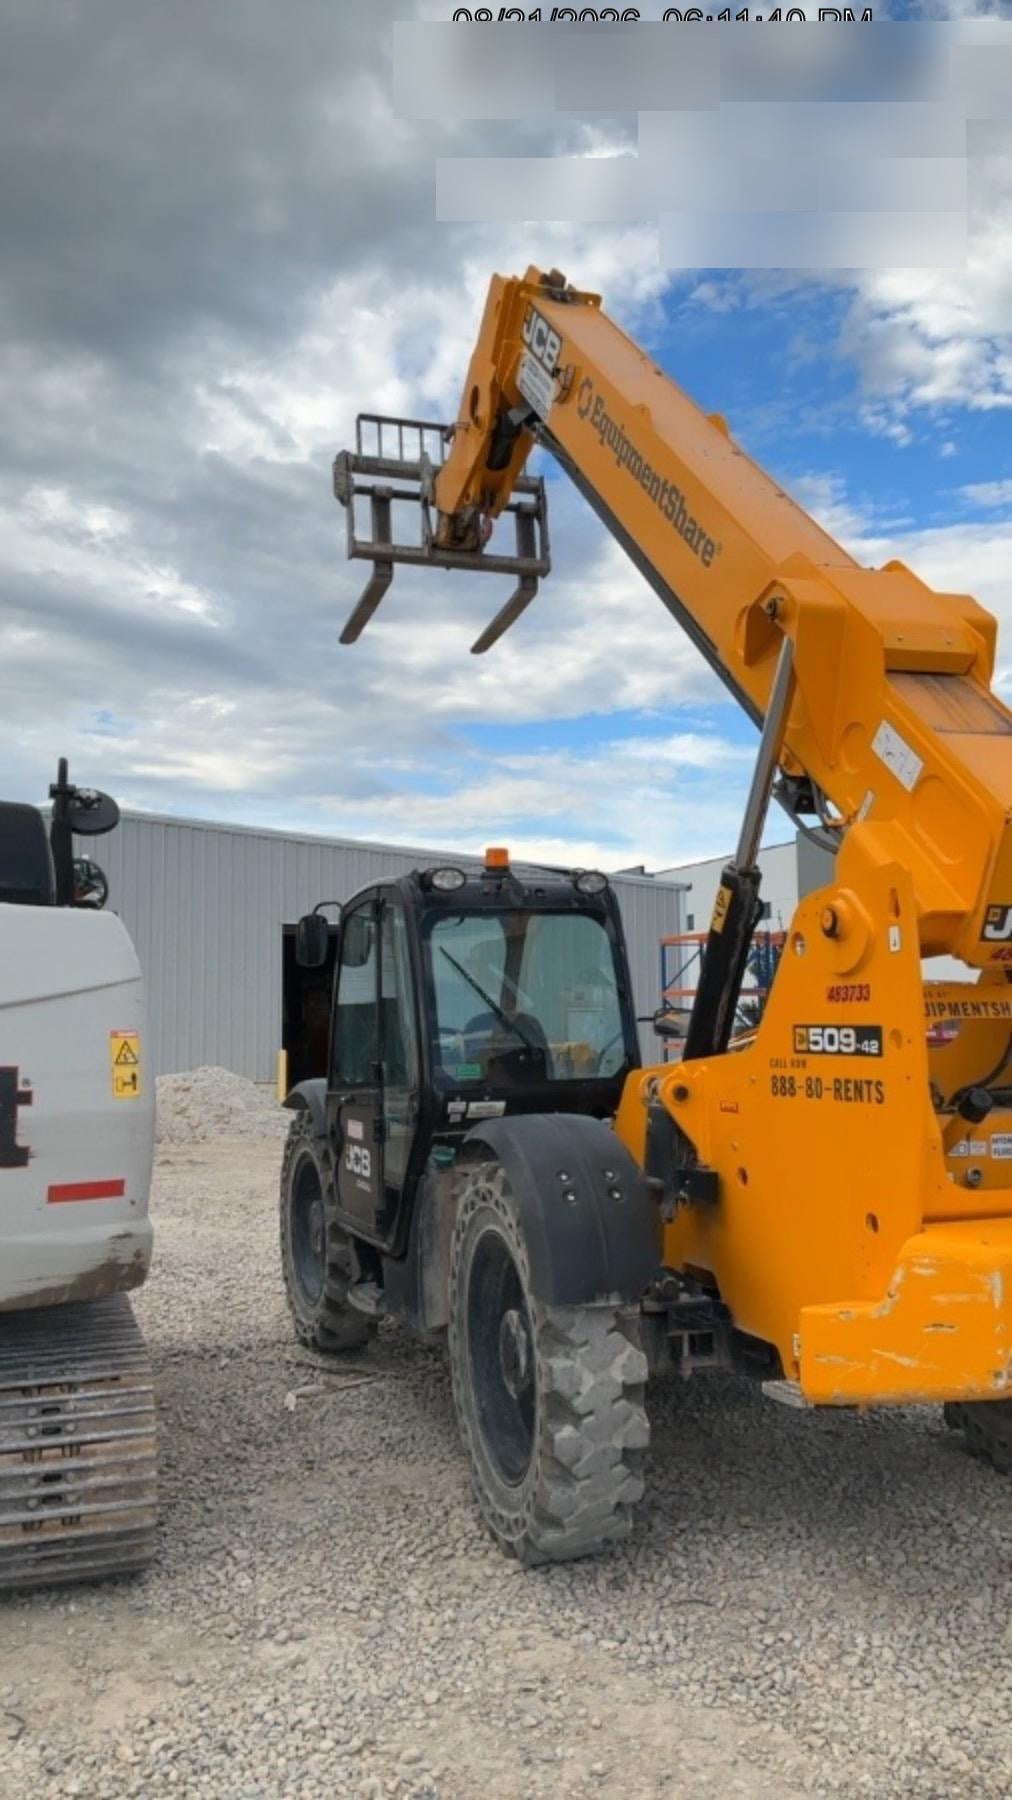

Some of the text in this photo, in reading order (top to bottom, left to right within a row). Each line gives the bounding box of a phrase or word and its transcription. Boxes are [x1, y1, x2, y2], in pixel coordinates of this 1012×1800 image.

[522, 310, 561, 374] JCB
[590, 394, 716, 568] EquipmentShare
[808, 1027, 880, 1055] 509-42
[770, 1074, 885, 1105] 888-80-RENTS
[345, 1144, 371, 1177] JCB
